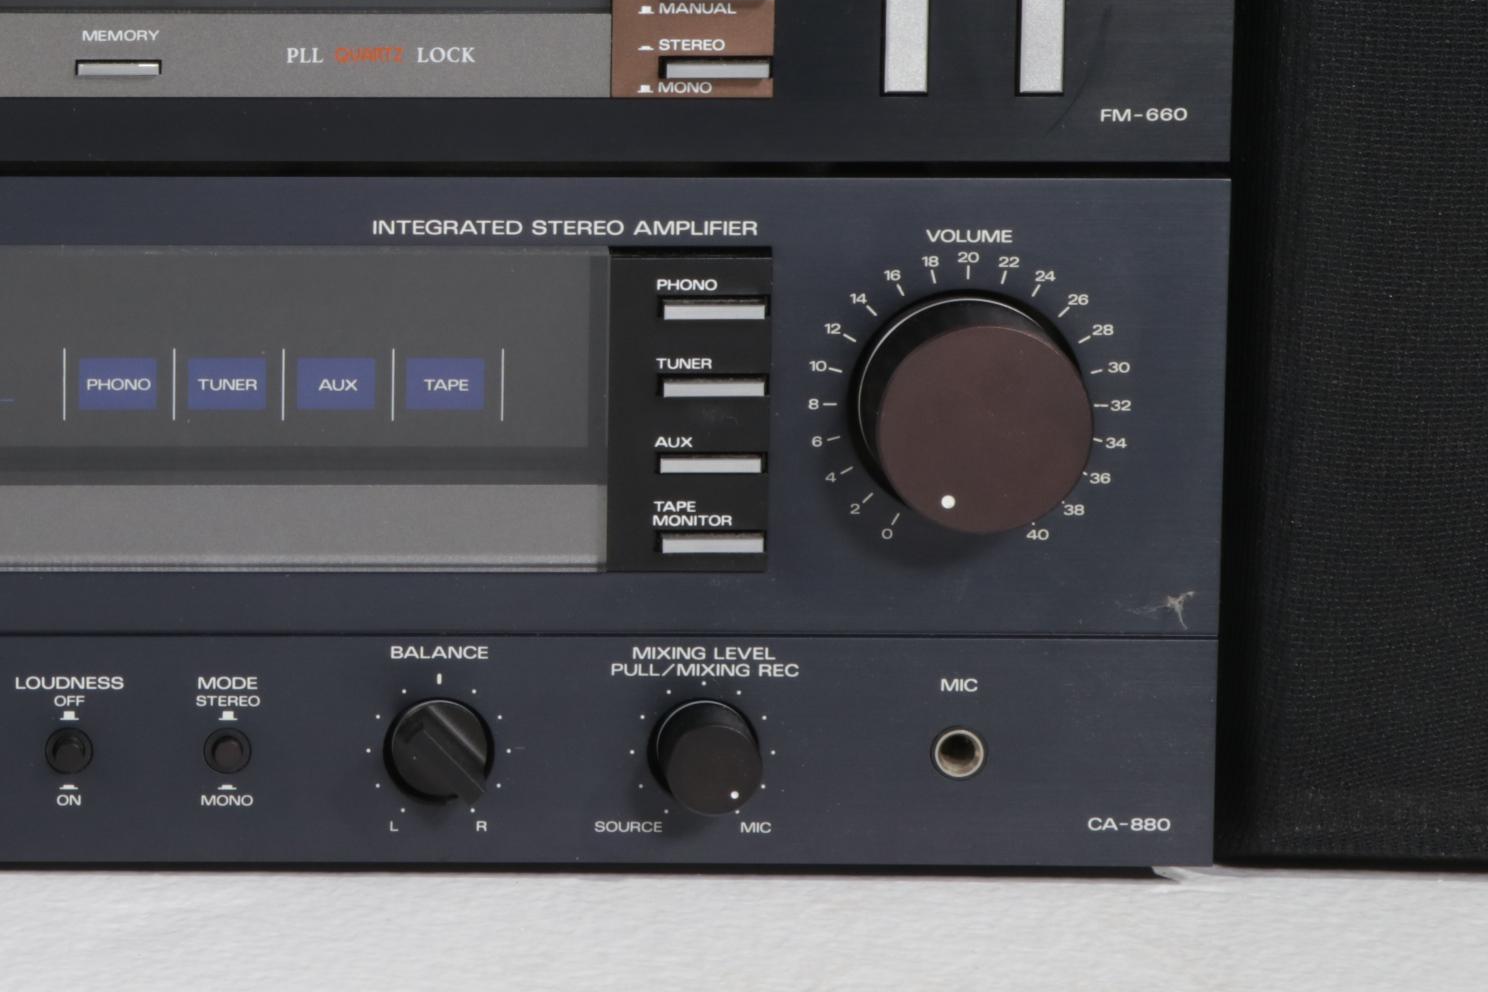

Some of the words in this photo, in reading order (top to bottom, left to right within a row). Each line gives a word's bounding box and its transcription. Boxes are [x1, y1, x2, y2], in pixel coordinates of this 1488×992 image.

[659, 3, 737, 14] MANUAL
[82, 30, 159, 41] MEMORY
[659, 39, 725, 51] STEREO
[287, 48, 323, 63] PLL
[417, 47, 475, 62] LOCK
[658, 82, 712, 94] MONO
[1101, 108, 1187, 122] FM-660
[373, 220, 522, 235] INTEGRATED
[532, 220, 624, 235] STEREO
[634, 221, 757, 235] AMPLIFIER
[926, 229, 1012, 243] VOLUME
[958, 252, 979, 263] 20
[657, 279, 717, 291] PHONO
[656, 358, 712, 369] TUNER
[87, 378, 151, 390] PHONO
[198, 379, 257, 391] TUNER
[319, 379, 357, 391] AUX
[424, 379, 468, 391] TAPE
[655, 437, 692, 448] AUX
[654, 501, 695, 512] TAPE
[653, 515, 732, 526] MONITOR
[1027, 529, 1049, 540] 40
[391, 646, 488, 659] BALANCE
[633, 647, 705, 660] MIXING
[714, 647, 775, 660] LEVEL
[611, 663, 750, 677] PULL/MIXING
[759, 664, 799, 677] REC
[16, 676, 124, 689] LOUDNESS
[198, 677, 257, 690] MODE
[941, 679, 977, 692] MIC
[54, 695, 84, 707] OFF
[196, 695, 260, 707] STEREO
[57, 795, 81, 806] ON
[201, 795, 253, 806] MONO
[390, 821, 398, 831] L
[476, 821, 487, 831] R
[595, 821, 661, 832] SOURCE
[741, 822, 771, 833] MIC
[1088, 817, 1170, 831] CA-880
